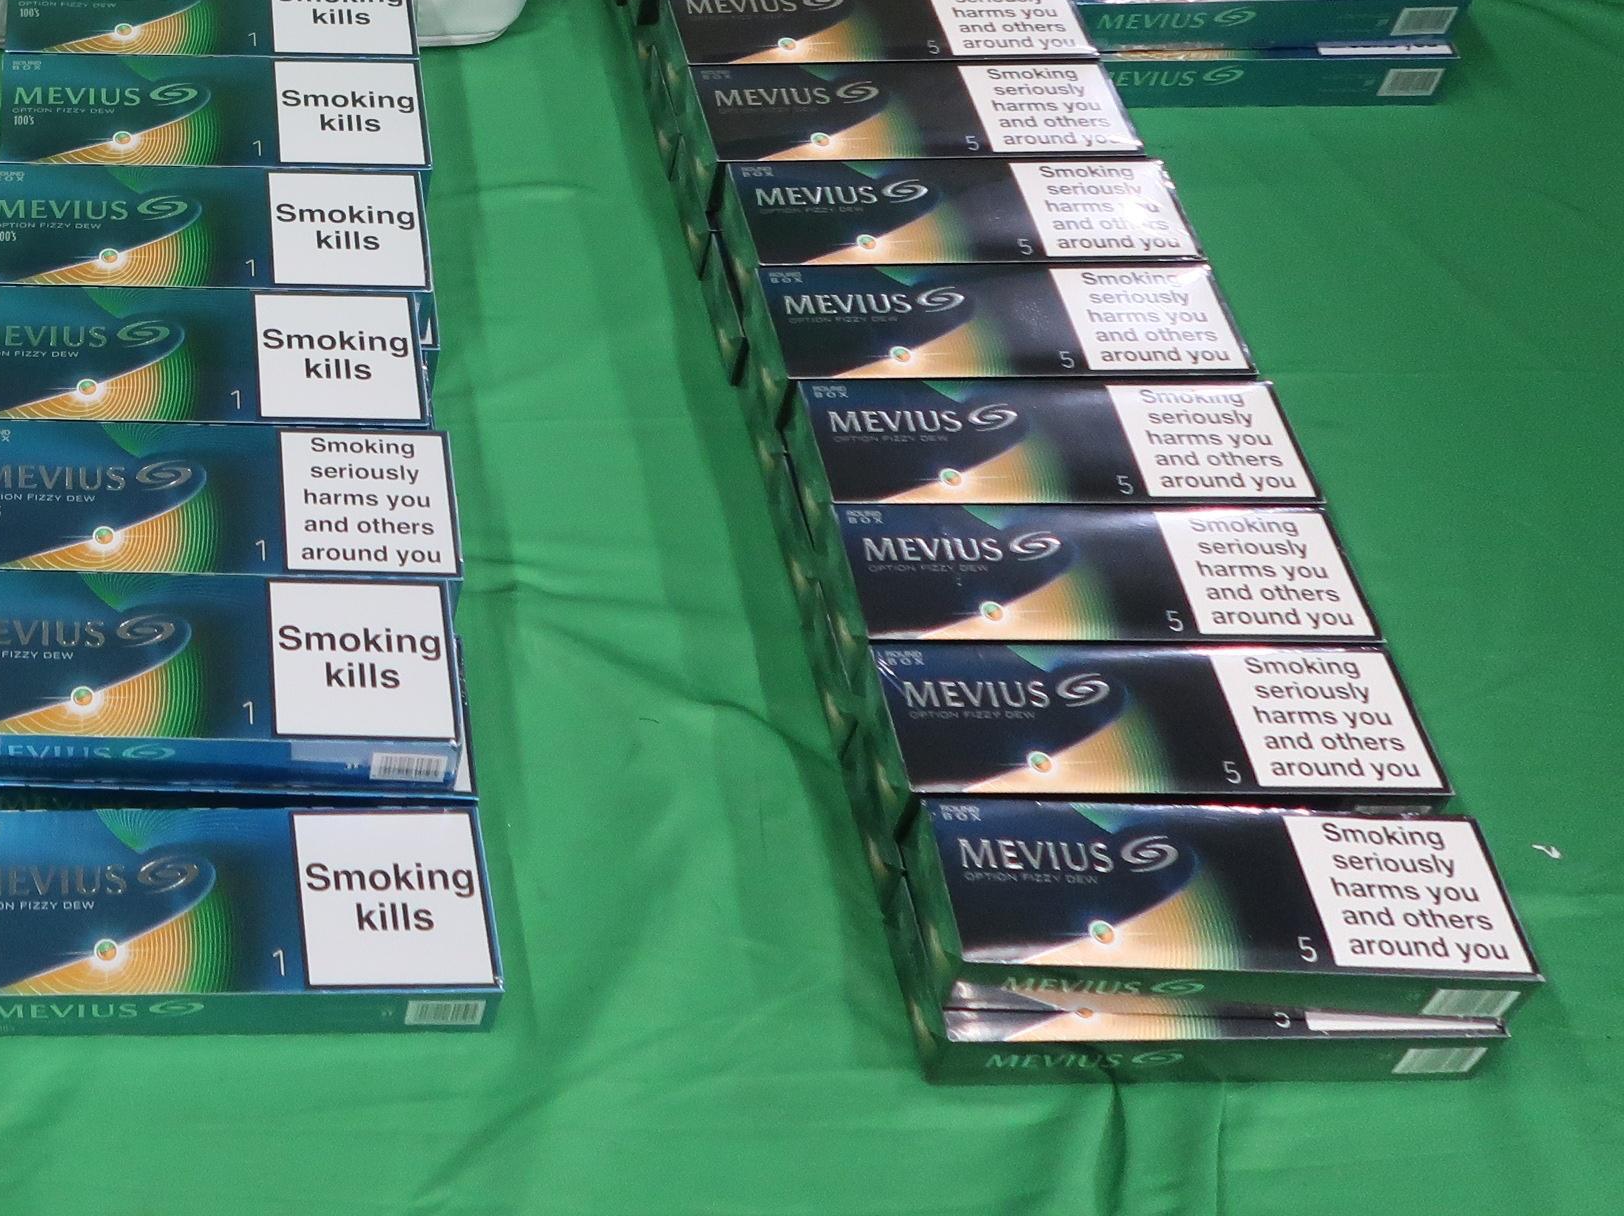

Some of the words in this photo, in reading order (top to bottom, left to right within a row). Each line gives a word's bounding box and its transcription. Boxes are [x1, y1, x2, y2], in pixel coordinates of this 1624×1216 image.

[312, 7, 371, 26] kills
[1097, 13, 1206, 29] MEVIUS
[14, 87, 141, 105] MEVIUS
[281, 89, 415, 114] Smoking
[715, 88, 830, 106] MEVIUS
[319, 113, 382, 133] kills
[965, 135, 980, 151] 5
[756, 184, 876, 205] MEVIUS
[275, 203, 416, 231] Smoking
[315, 229, 381, 251] kills
[245, 259, 255, 277] 1
[784, 293, 911, 315] MEVIUS
[262, 328, 409, 359] Smoking
[304, 357, 372, 381] kills
[828, 410, 962, 433] MEVIUS
[310, 436, 415, 460] Smoking
[310, 462, 420, 486] seriously
[1116, 475, 1134, 495] 5
[303, 488, 379, 507] harms
[385, 494, 431, 512] you
[303, 515, 349, 534] and
[356, 517, 435, 536] others
[1189, 517, 1300, 538] Smoking
[300, 544, 389, 563] around
[395, 548, 442, 568] you
[864, 535, 1003, 562] MEVIUS
[1197, 538, 1308, 560] seriously
[1194, 559, 1278, 578] harms
[1279, 565, 1330, 582] you
[1205, 583, 1255, 601] and
[1259, 583, 1342, 603] others
[1210, 607, 1303, 626] around
[1304, 611, 1356, 631] you
[278, 624, 442, 662] Smoking
[2, 651, 38, 659] FIZZY
[43, 652, 73, 660] DEW
[325, 661, 401, 689] kills
[1243, 656, 1362, 680] Smoking
[903, 676, 1050, 709] MEVIUS
[1254, 680, 1370, 705] seriously
[1251, 704, 1339, 726] harms
[1341, 710, 1394, 730] you
[1263, 730, 1316, 751] and
[1320, 731, 1407, 752] others
[1269, 757, 1366, 777] around
[1368, 762, 1422, 782] you
[1320, 821, 1446, 852] Smoking
[959, 837, 1113, 873] MEVIUS
[1331, 851, 1455, 879] seriously
[305, 862, 475, 899] Smoking
[1329, 876, 1422, 901] harms
[1423, 885, 1481, 906] you
[20, 901, 57, 910] FIZZY
[62, 901, 94, 909] DEW
[355, 901, 435, 932] kills
[1341, 905, 1396, 927] and
[1402, 907, 1494, 931] others
[1298, 936, 1318, 963] 5
[1348, 935, 1451, 958] around
[1453, 941, 1511, 964] you
[272, 949, 285, 976] 1
